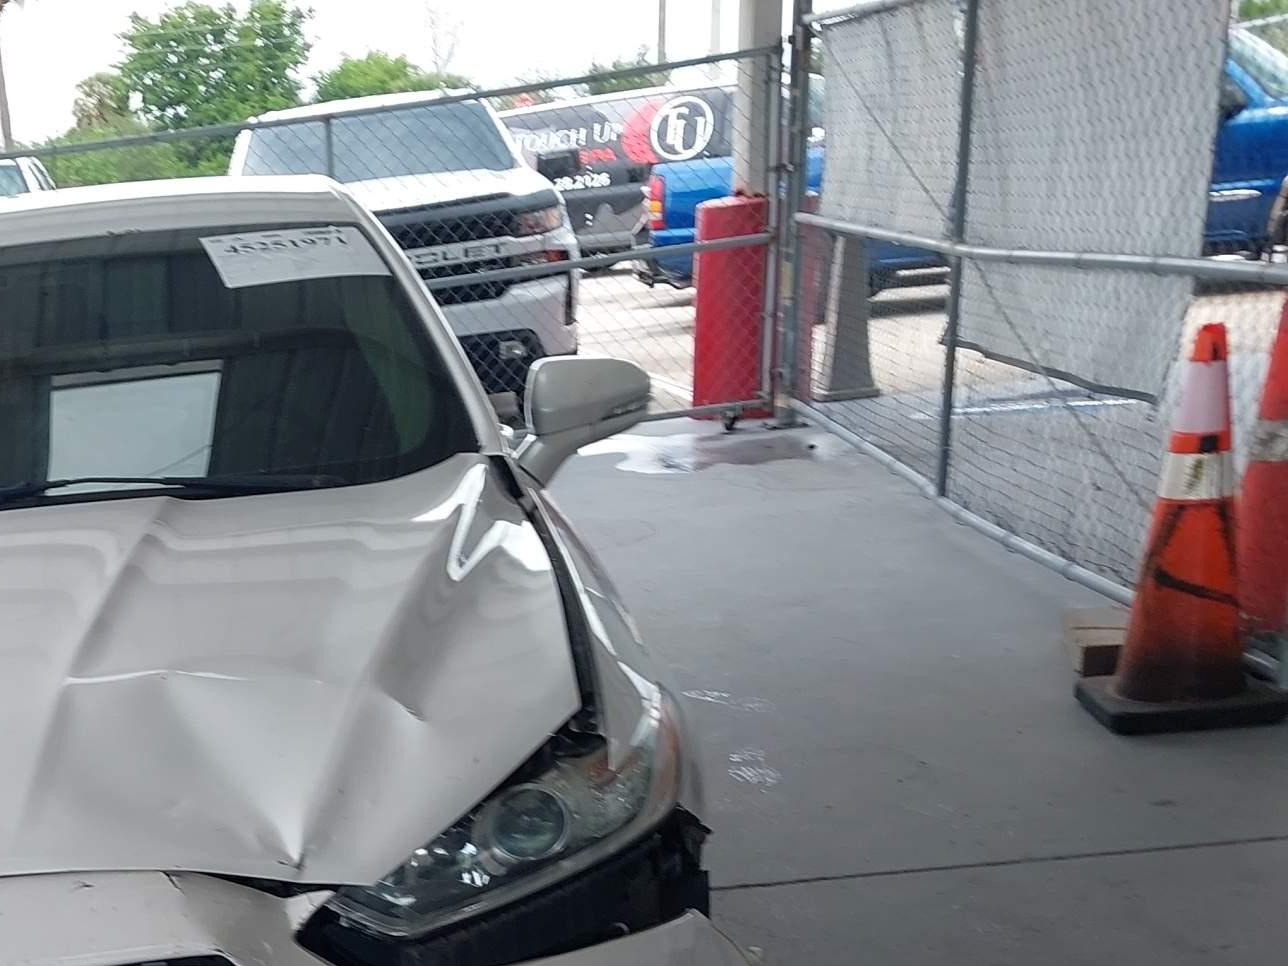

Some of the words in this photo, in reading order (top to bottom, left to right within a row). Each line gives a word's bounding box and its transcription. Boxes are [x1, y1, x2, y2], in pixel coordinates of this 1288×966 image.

[513, 127, 587, 150] TOUCH
[593, 121, 624, 144] UP
[224, 236, 348, 254] 45251971
[408, 242, 509, 264] OLET
